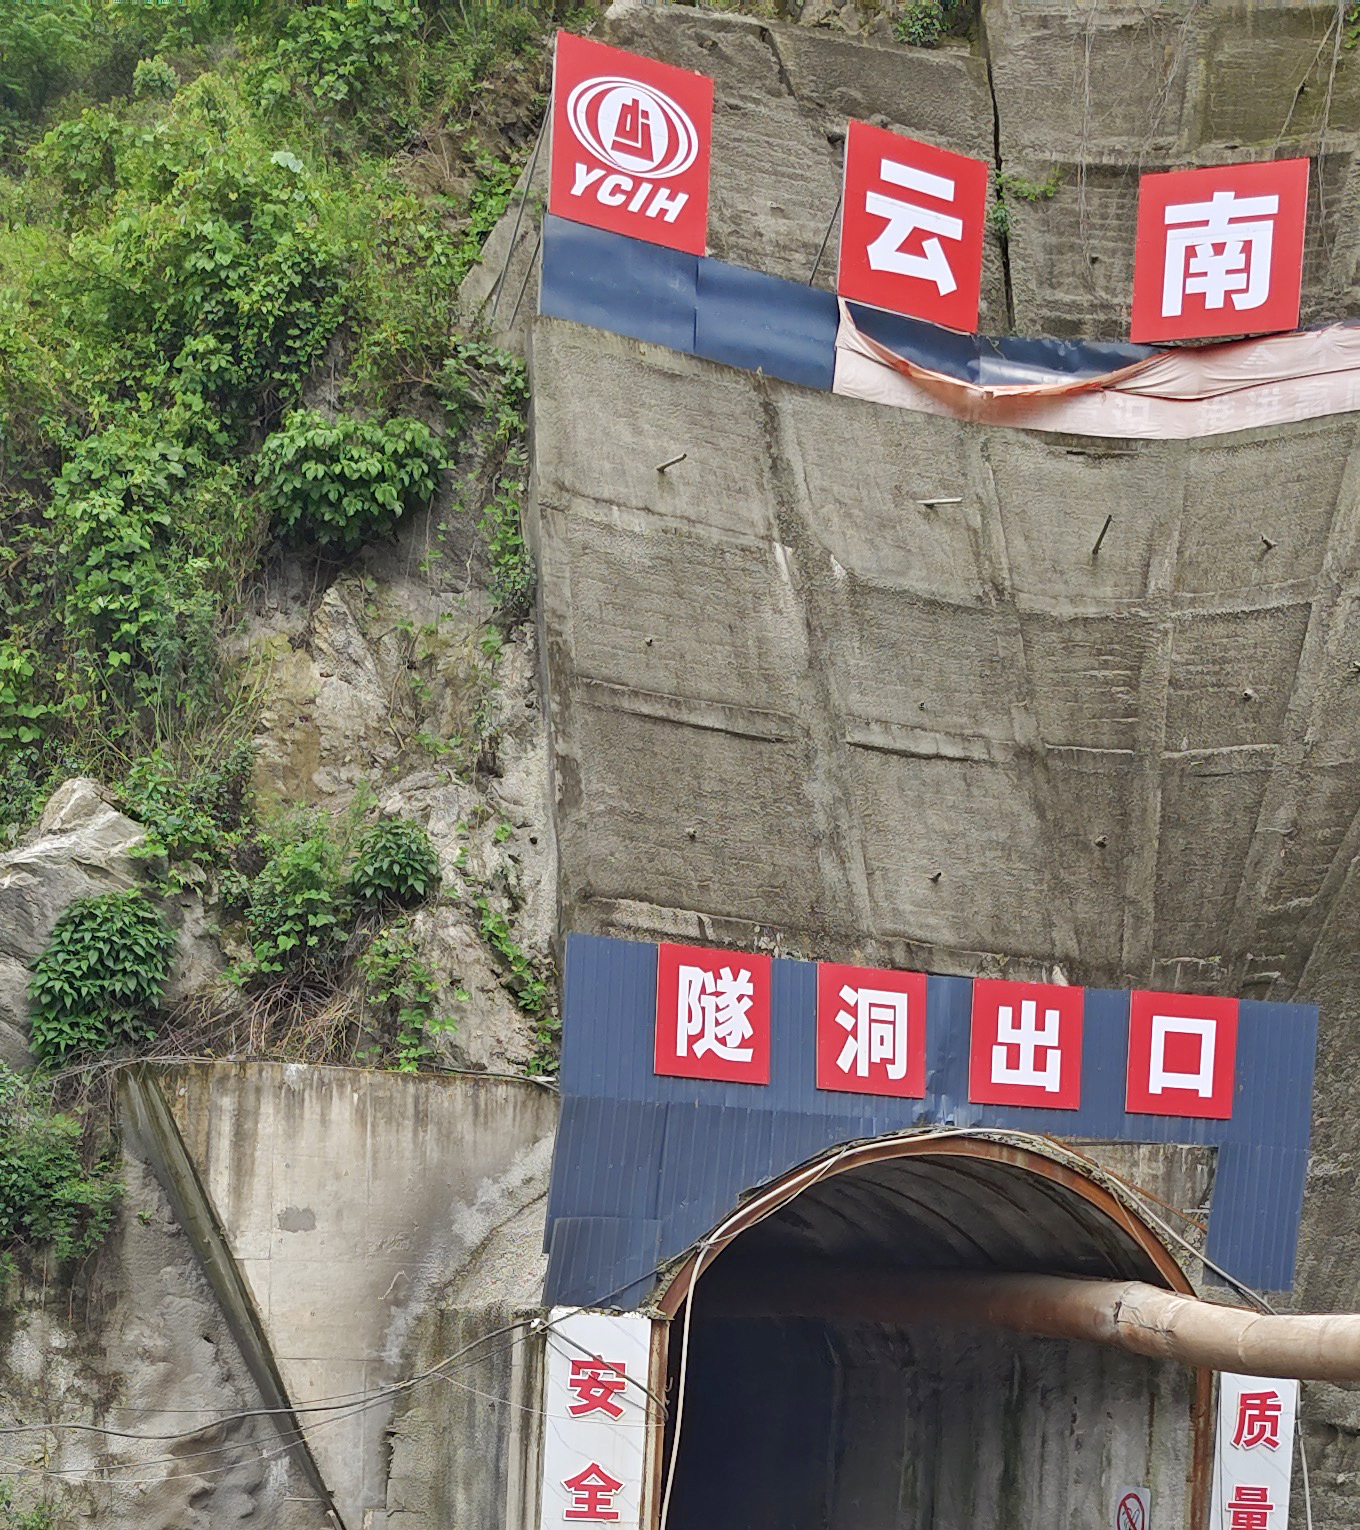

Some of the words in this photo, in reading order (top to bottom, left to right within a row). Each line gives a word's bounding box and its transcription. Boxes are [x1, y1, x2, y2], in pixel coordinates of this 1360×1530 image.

[569, 162, 690, 225] YCIH
[675, 965, 1218, 1098] 隧洞出口
